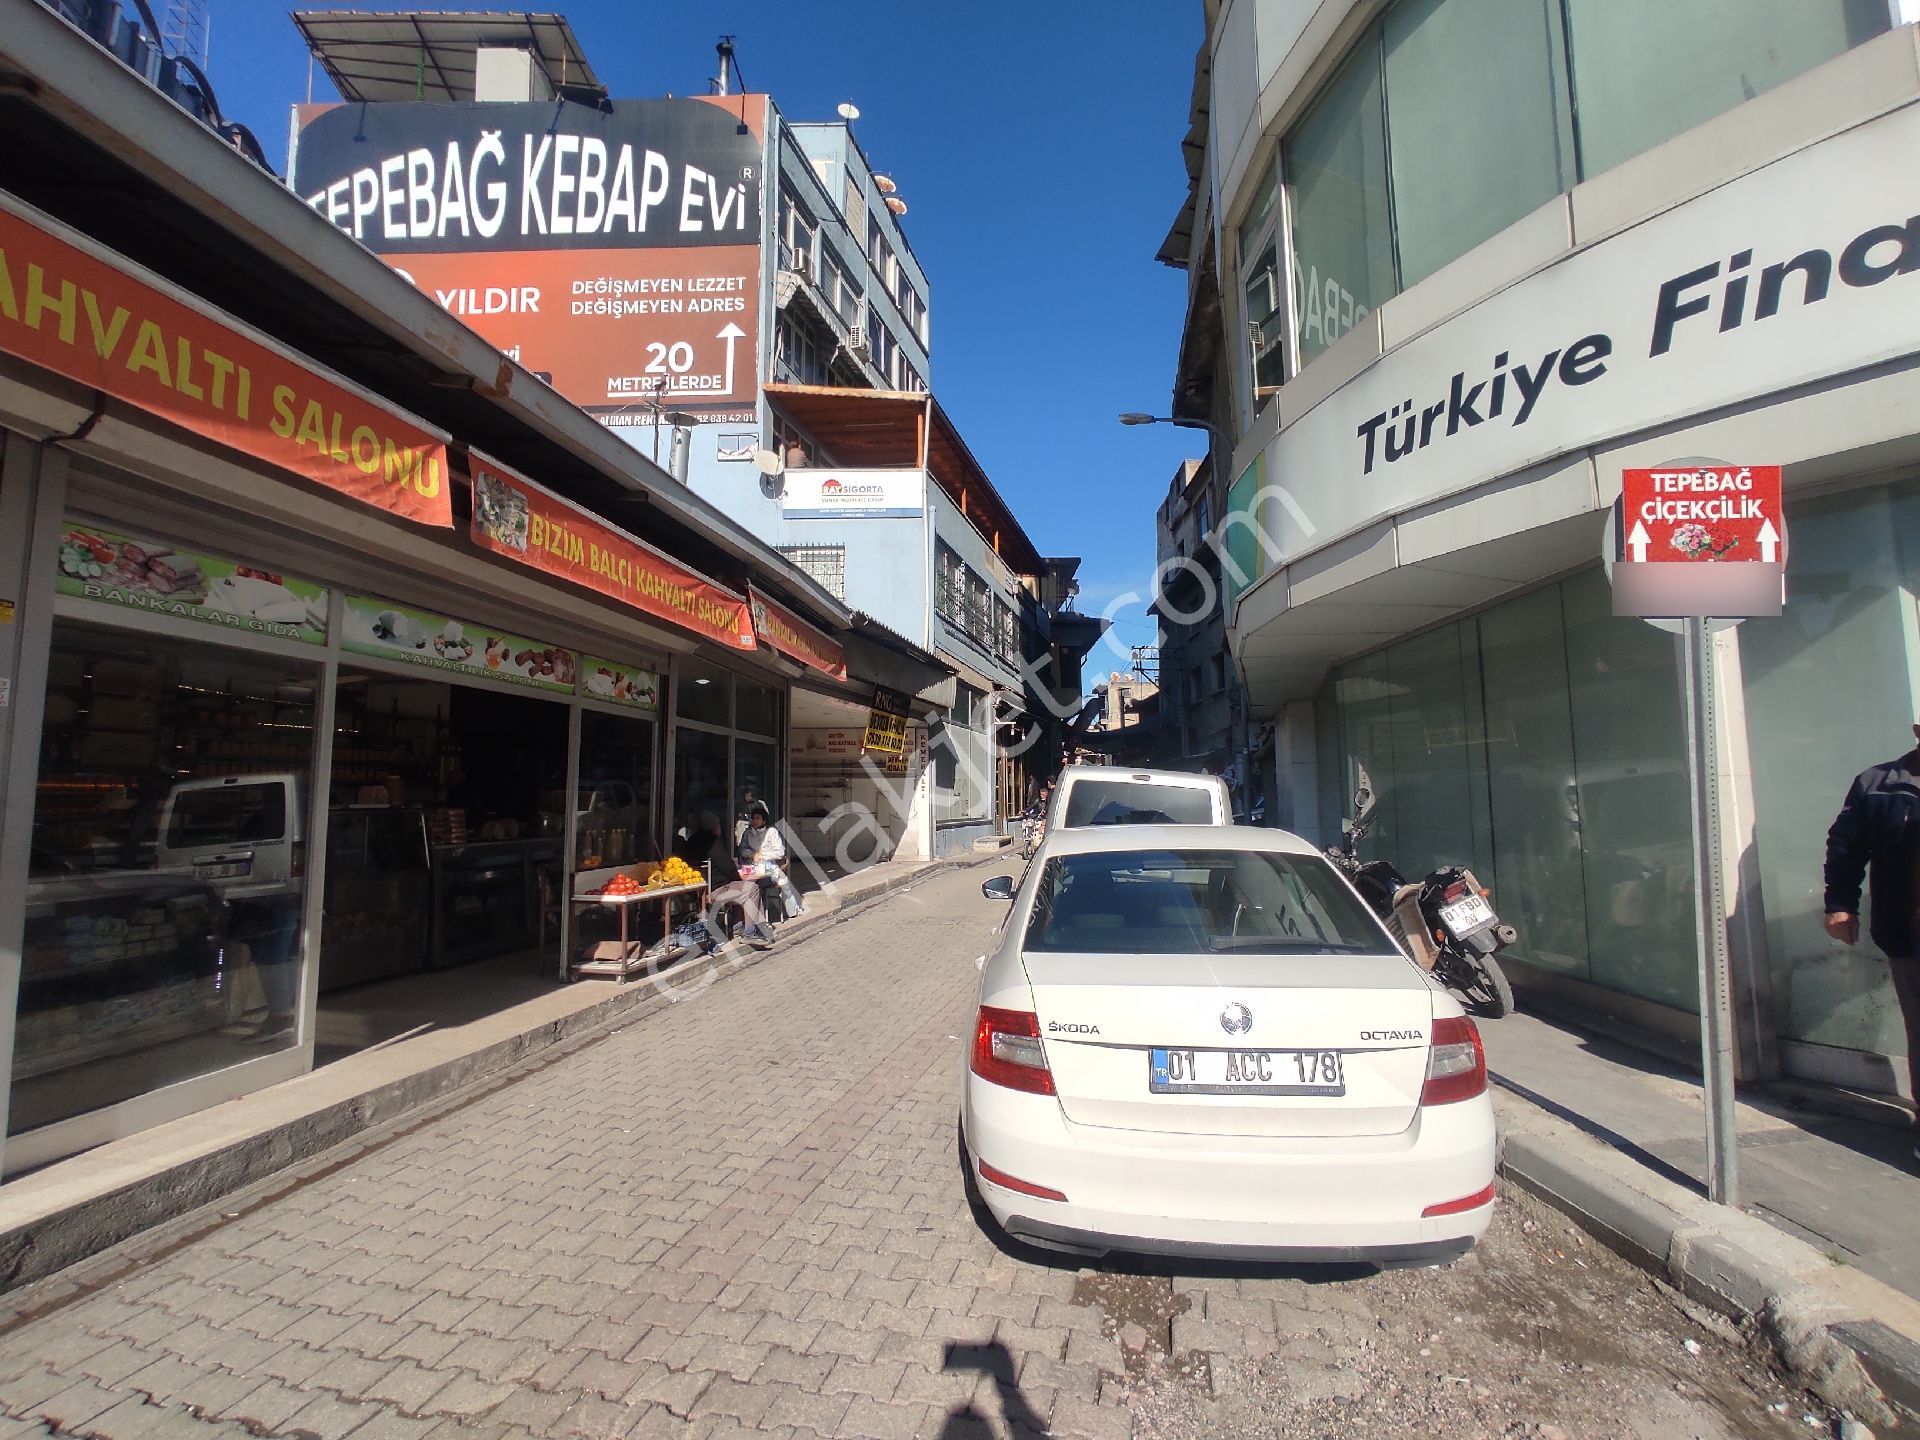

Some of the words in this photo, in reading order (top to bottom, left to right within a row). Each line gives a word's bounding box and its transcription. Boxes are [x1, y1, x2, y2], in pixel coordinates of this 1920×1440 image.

[521, 133, 669, 236] KEBAP
[436, 287, 541, 315] YILDIR
[572, 277, 683, 298] DEĞİŞMEYEN
[688, 276, 747, 292] LEZZET
[571, 297, 683, 319] DEĞİŞMEYEN
[687, 297, 745, 313] ADRES
[645, 341, 694, 373] 20
[1357, 333, 1613, 476] Türkiye
[1649, 215, 1920, 358] Fina
[633, 415, 671, 426] REKA
[270, 384, 440, 498] SALONU
[1651, 468, 1753, 493] TEPEBAĞ
[1641, 495, 1764, 525] ÇİÇEKÇİLİK
[531, 511, 584, 566] BİZİM
[636, 565, 696, 616] KAHVALTI
[698, 598, 740, 635] SALONU
[83, 583, 240, 627] BANKALAR
[248, 619, 302, 639] GIDA
[1360, 1029, 1423, 1041] OCTAVIA
[1168, 1051, 1196, 1081] 01
[1226, 1051, 1273, 1082] ACC
[1293, 1052, 1338, 1083] 178
